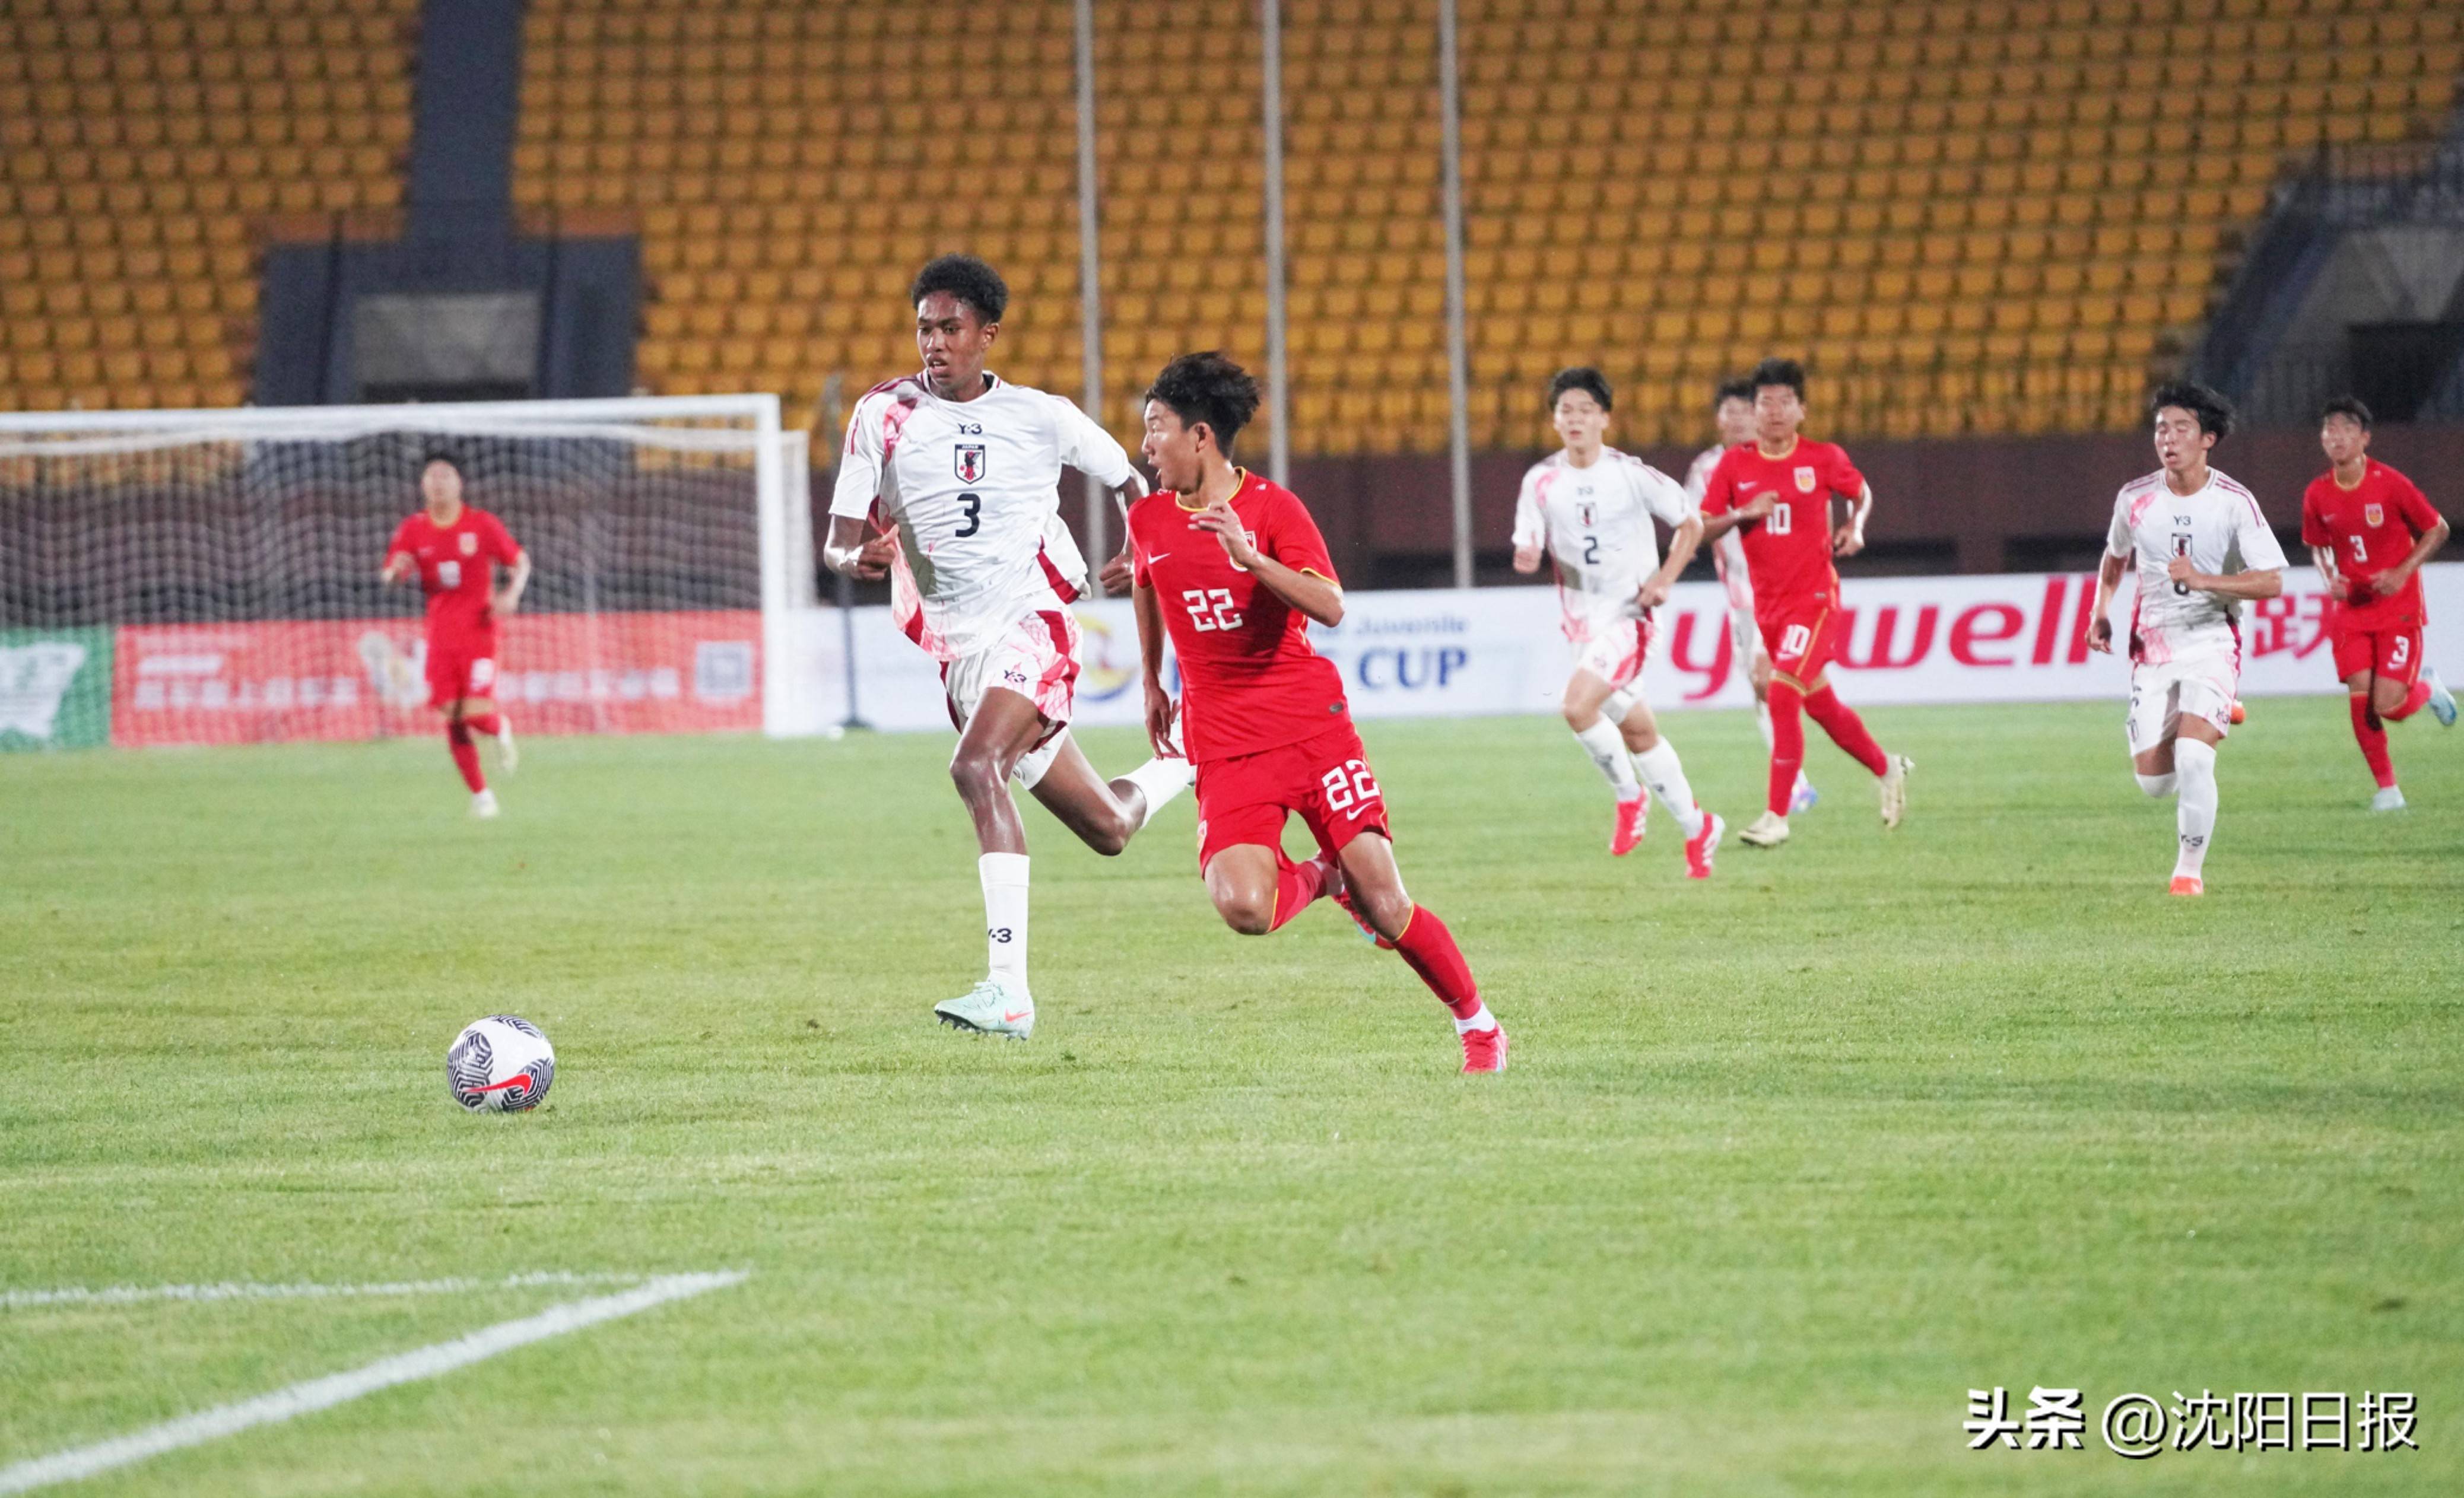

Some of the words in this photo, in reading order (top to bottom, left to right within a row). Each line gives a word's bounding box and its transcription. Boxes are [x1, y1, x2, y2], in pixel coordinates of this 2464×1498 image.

[957, 422, 982, 435] Y-3
[955, 493, 981, 538] 3
[1583, 536, 1601, 564] 2
[2349, 536, 2368, 562] 3
[1183, 589, 1243, 632] 22
[1781, 624, 1810, 656] 10
[2392, 635, 2409, 663] 3
[1358, 647, 1466, 688] CUP
[1321, 759, 1380, 812] 22
